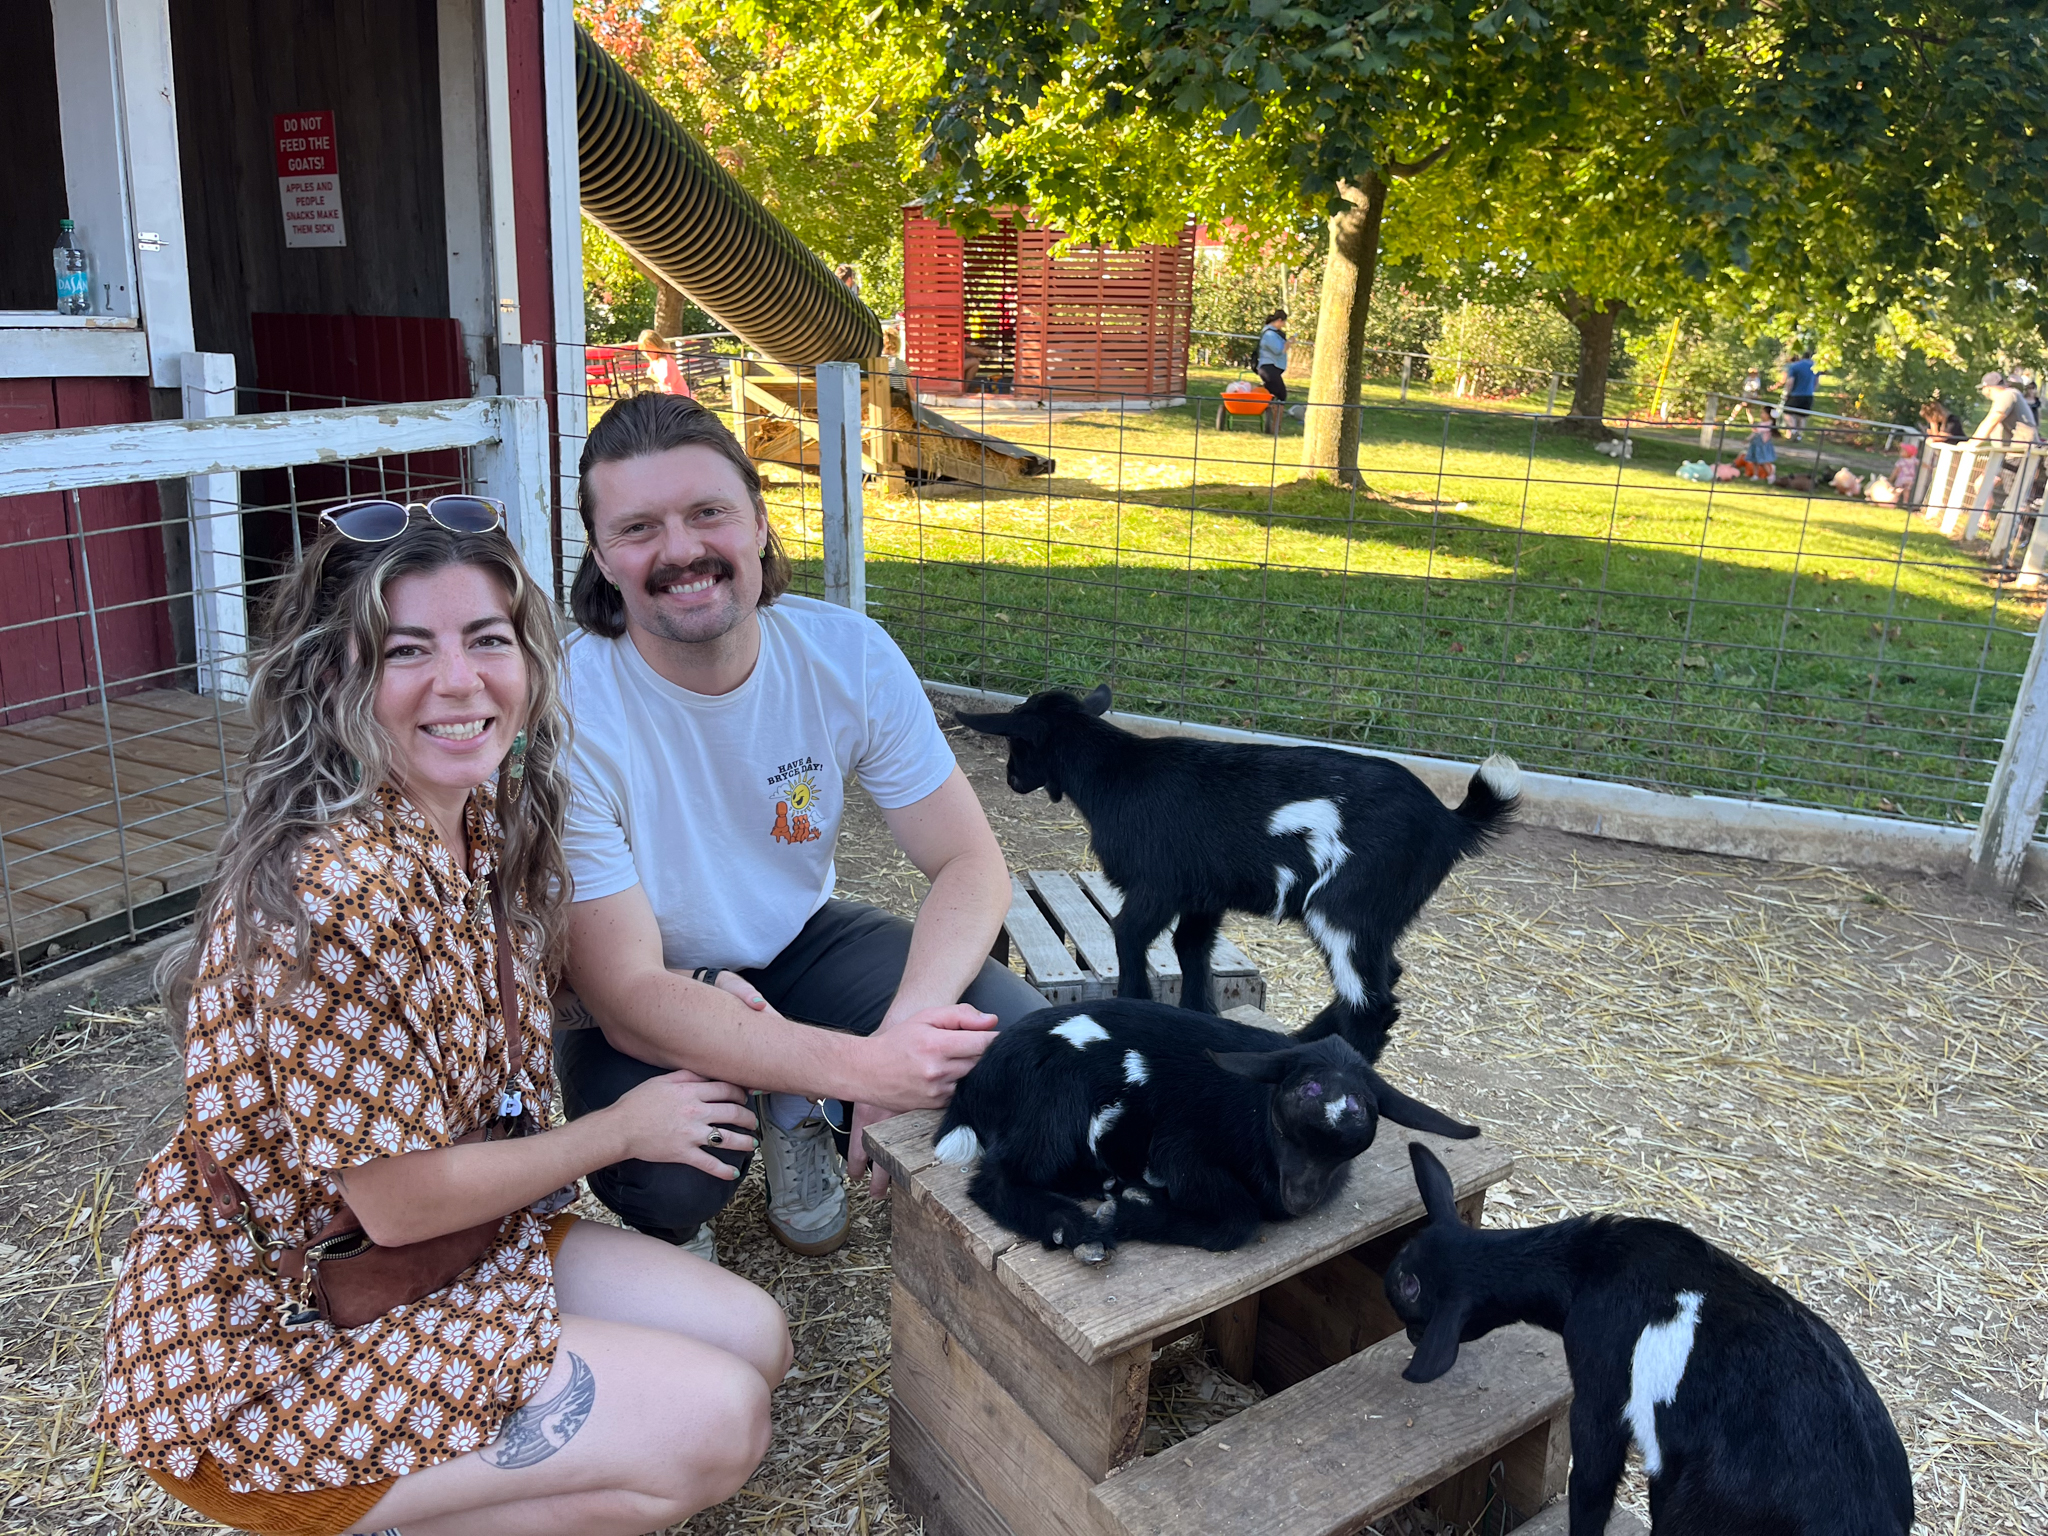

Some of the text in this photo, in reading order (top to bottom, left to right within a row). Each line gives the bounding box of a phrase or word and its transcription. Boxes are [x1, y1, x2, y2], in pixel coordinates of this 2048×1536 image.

[284, 117, 322, 132] DO NOT
[280, 136, 330, 152] FEED THE
[288, 157, 325, 171] GOATS!
[286, 181, 333, 193] APPLES AND
[296, 196, 325, 206] PEOPLE
[286, 209, 339, 221] SNACKS MAKE
[292, 223, 335, 234] THEM SICK!
[778, 756, 812, 773] HAVE A
[767, 763, 823, 785] BRYCE DAY!
